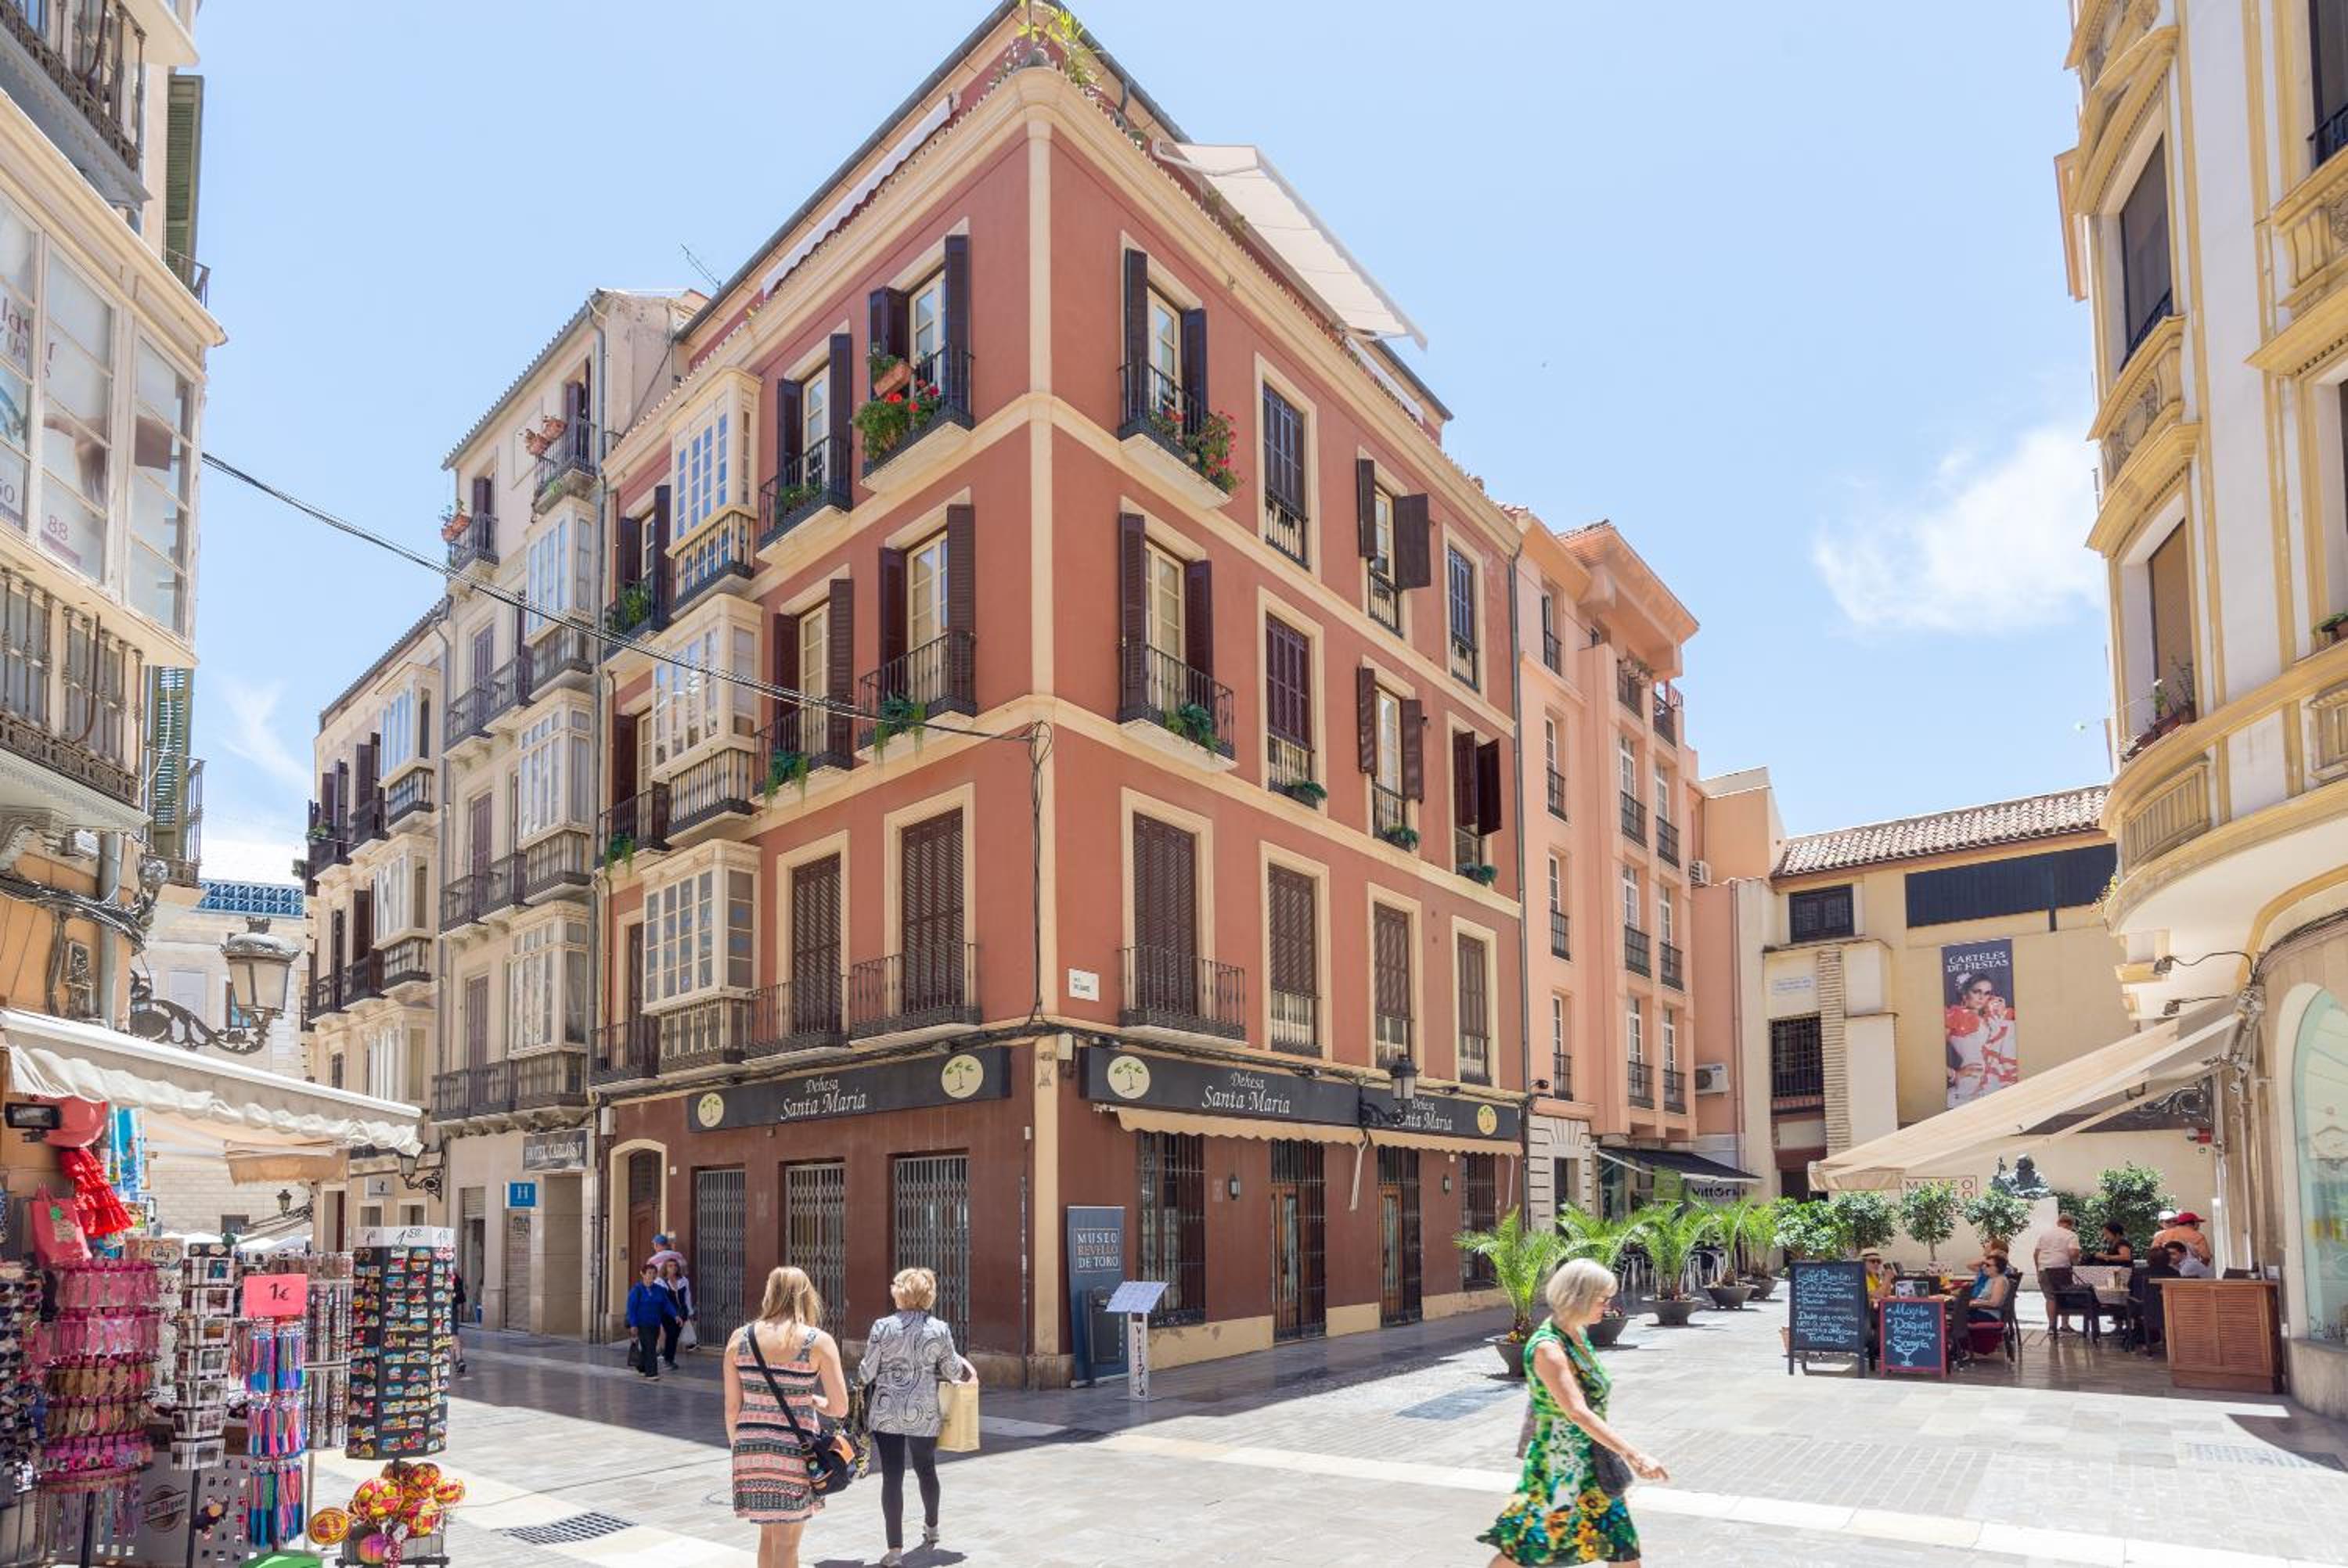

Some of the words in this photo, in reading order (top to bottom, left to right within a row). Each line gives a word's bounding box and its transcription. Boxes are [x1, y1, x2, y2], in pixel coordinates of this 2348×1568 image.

[1949, 951, 2006, 965] CARTELES
[1947, 963, 1962, 973] DE
[1965, 959, 2009, 971] FIESTAS
[1201, 1085, 1245, 1108] Santa
[780, 1098, 819, 1120] Santa
[517, 1185, 528, 1199] H
[1077, 1232, 1118, 1245] MUSEO
[1077, 1257, 1092, 1268] DE
[1094, 1255, 1118, 1267] TORO
[269, 1282, 290, 1301] 1€
